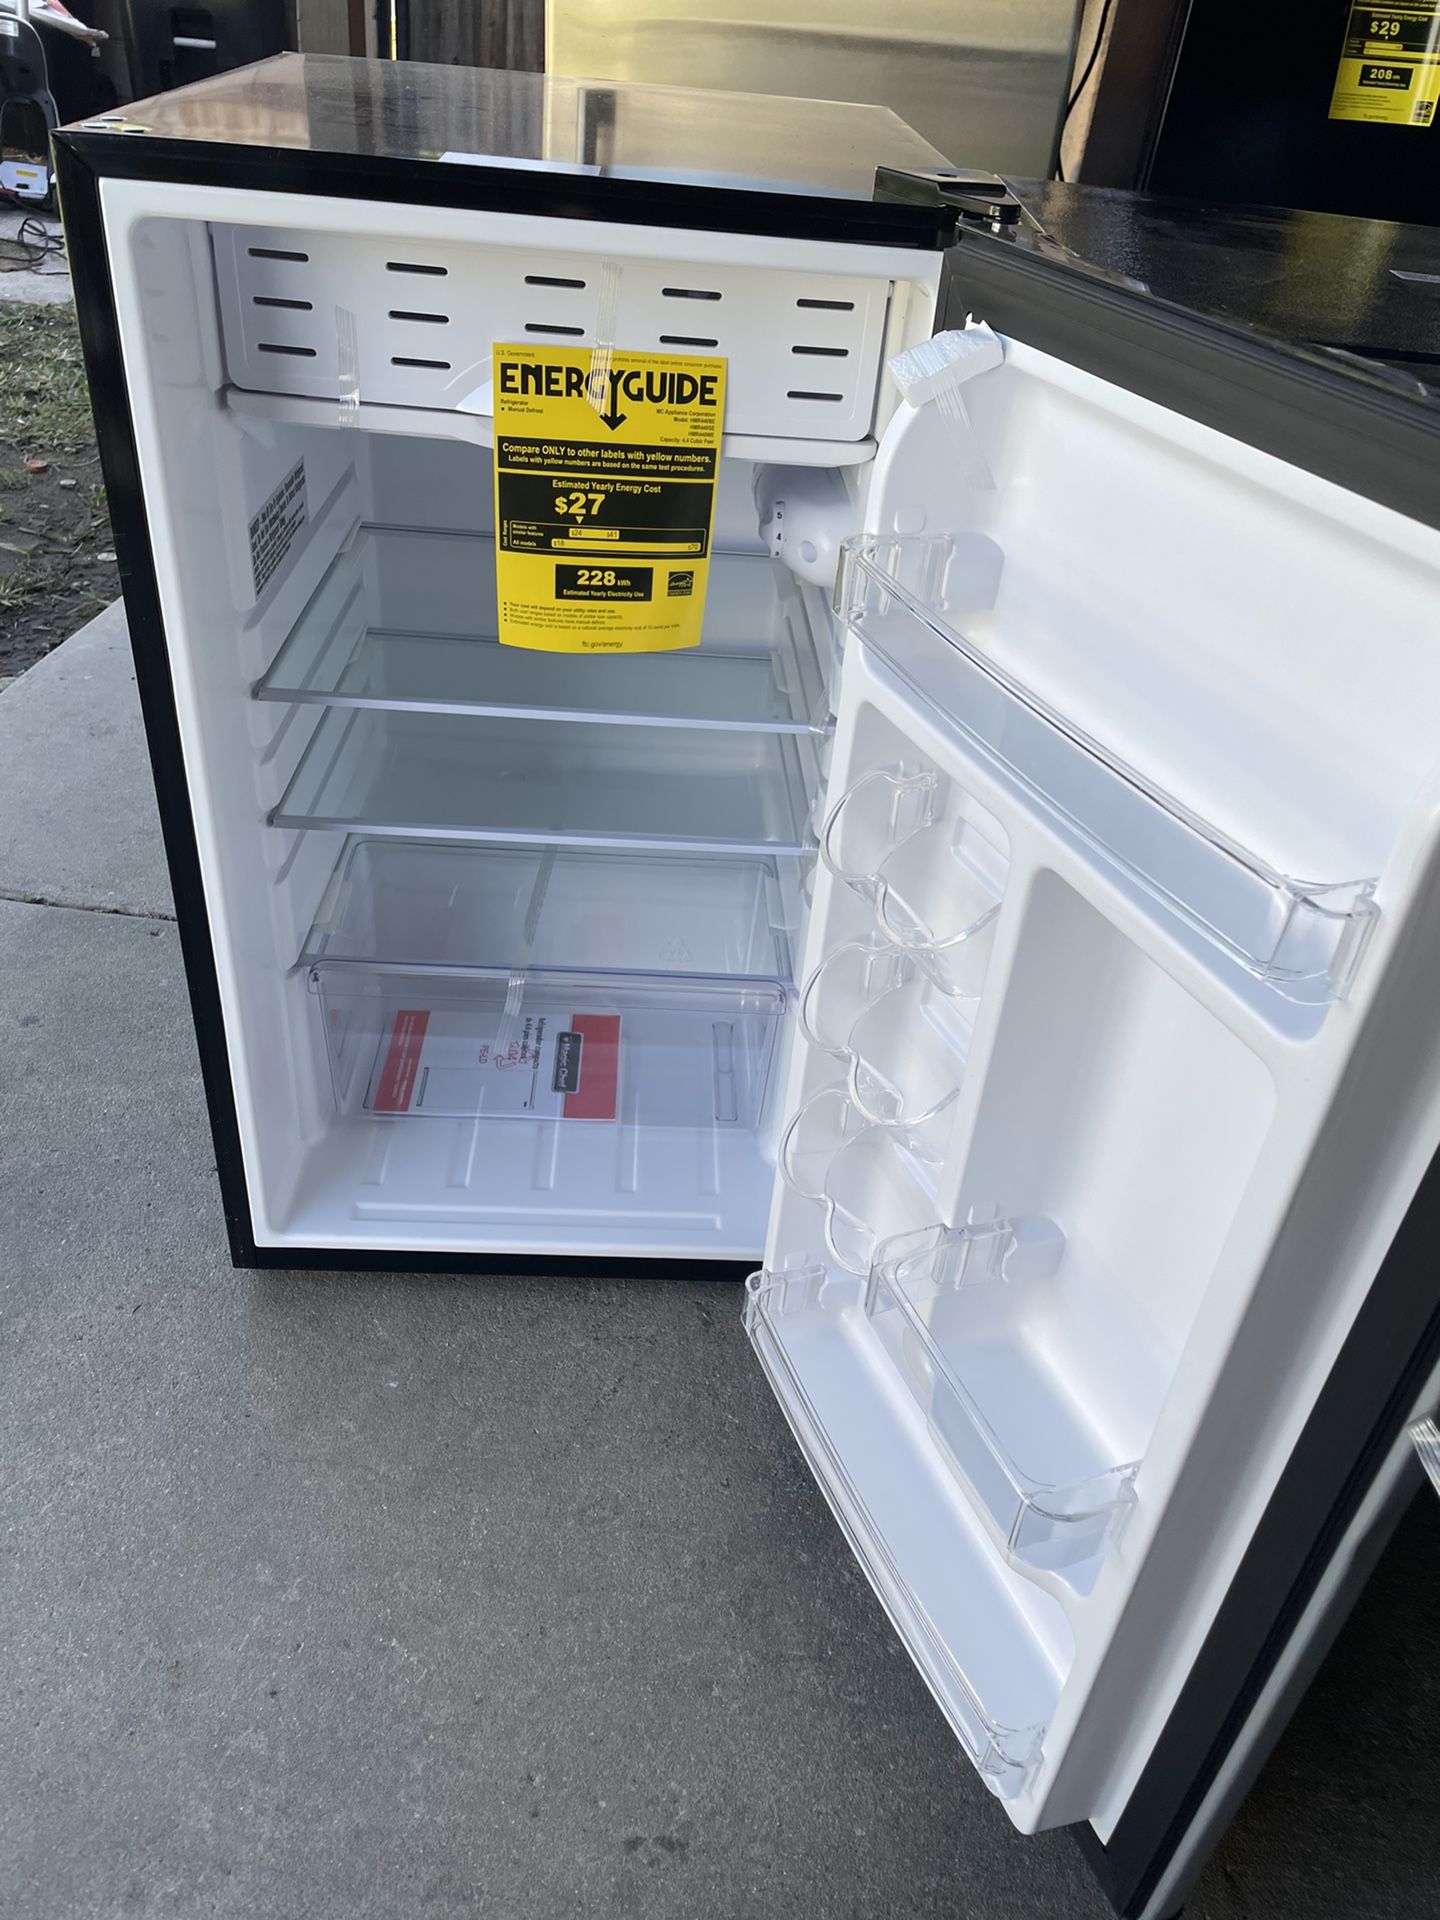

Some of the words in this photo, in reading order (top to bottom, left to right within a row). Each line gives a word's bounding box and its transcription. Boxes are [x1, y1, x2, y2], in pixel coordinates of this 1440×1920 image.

[1370, 21, 1401, 36] $29
[1370, 68, 1393, 80] 208
[501, 362, 718, 407] ENERGYGUIDE
[502, 442, 540, 454] Compare
[542, 445, 566, 455] ONLY
[567, 448, 576, 456] to
[577, 448, 600, 457] other
[601, 449, 625, 459] labels
[627, 451, 644, 460] with
[646, 452, 673, 462] yellow
[674, 454, 712, 463] numbers.
[508, 455, 529, 463] Labels
[544, 457, 563, 465] yellow
[552, 480, 590, 490] Estimated
[592, 482, 614, 492] Yearly
[616, 483, 642, 494] Energy
[644, 484, 661, 493] Cost
[555, 492, 606, 515] $27
[777, 512, 782, 520] 5
[776, 533, 781, 541] 4
[577, 570, 616, 586] 228
[560, 1044, 571, 1067] Magic
[560, 1068, 568, 1088] Chef
